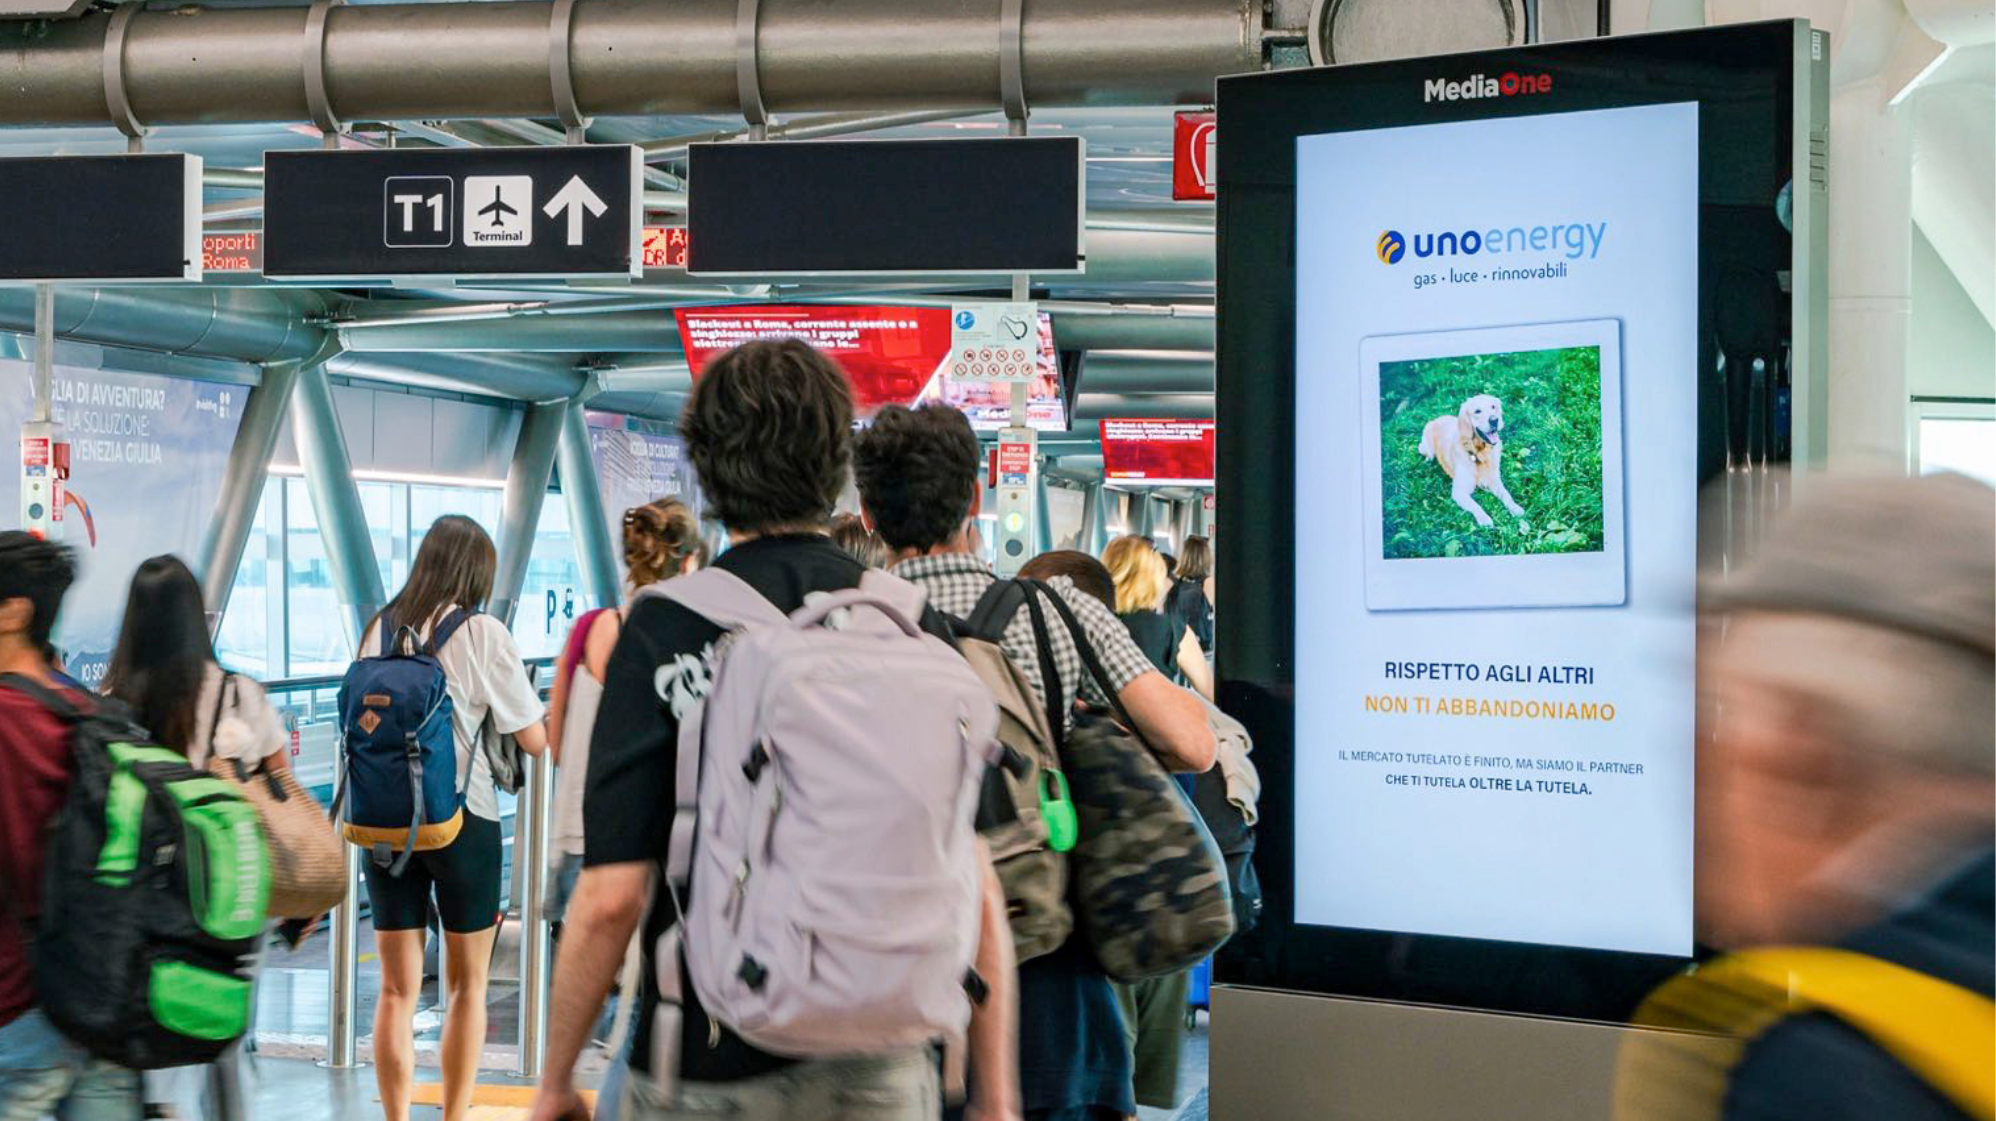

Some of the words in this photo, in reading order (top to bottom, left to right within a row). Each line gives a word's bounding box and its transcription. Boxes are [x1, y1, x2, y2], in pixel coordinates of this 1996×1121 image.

[1424, 73, 1552, 102] MediaOne
[394, 194, 443, 231] T1
[203, 233, 255, 254] oporti
[473, 231, 523, 241] Terminal
[670, 228, 687, 247] A
[202, 252, 250, 269] Roma
[676, 248, 687, 265] d
[1414, 274, 1437, 289] gas
[1450, 267, 1478, 283] luce
[1492, 262, 1567, 281] rinnovabili
[687, 320, 741, 329] Blackout
[753, 320, 792, 330] Roma,
[793, 320, 847, 329] corrente
[848, 320, 897, 329] assente
[819, 329, 859, 341] gruppi
[28, 376, 73, 402] VLIA
[77, 381, 89, 404] DI
[91, 383, 166, 410] AVVENTURA?
[68, 409, 81, 432] LA
[84, 411, 150, 437] SOLUZIONE:
[74, 439, 124, 462] VENEZIA
[125, 442, 162, 464] GIULIA
[92, 662, 108, 681] SON
[1385, 661, 1480, 681] RISPETTO
[1485, 665, 1532, 683] AGLI
[1537, 667, 1594, 685] ALTRI
[1365, 694, 1408, 713] NON
[1413, 697, 1430, 714] TI
[1435, 698, 1616, 721] ABBANDONIAMO
[1339, 750, 1348, 761] IL
[1351, 751, 1403, 763] MERCATO
[1406, 753, 1462, 766] TUTELATO
[1474, 756, 1513, 769] FINITO,
[1516, 758, 1533, 769] MA
[1536, 759, 1574, 772] SIAMO
[1577, 761, 1587, 772] IL
[1590, 761, 1643, 774] PARTNER
[1385, 774, 1408, 785] CHE
[1411, 775, 1421, 786] TI
[1424, 776, 1466, 788] TUTELA
[1469, 777, 1512, 790] OLTRE
[1516, 780, 1533, 792] LA
[1536, 780, 1593, 795] TUTELA.
